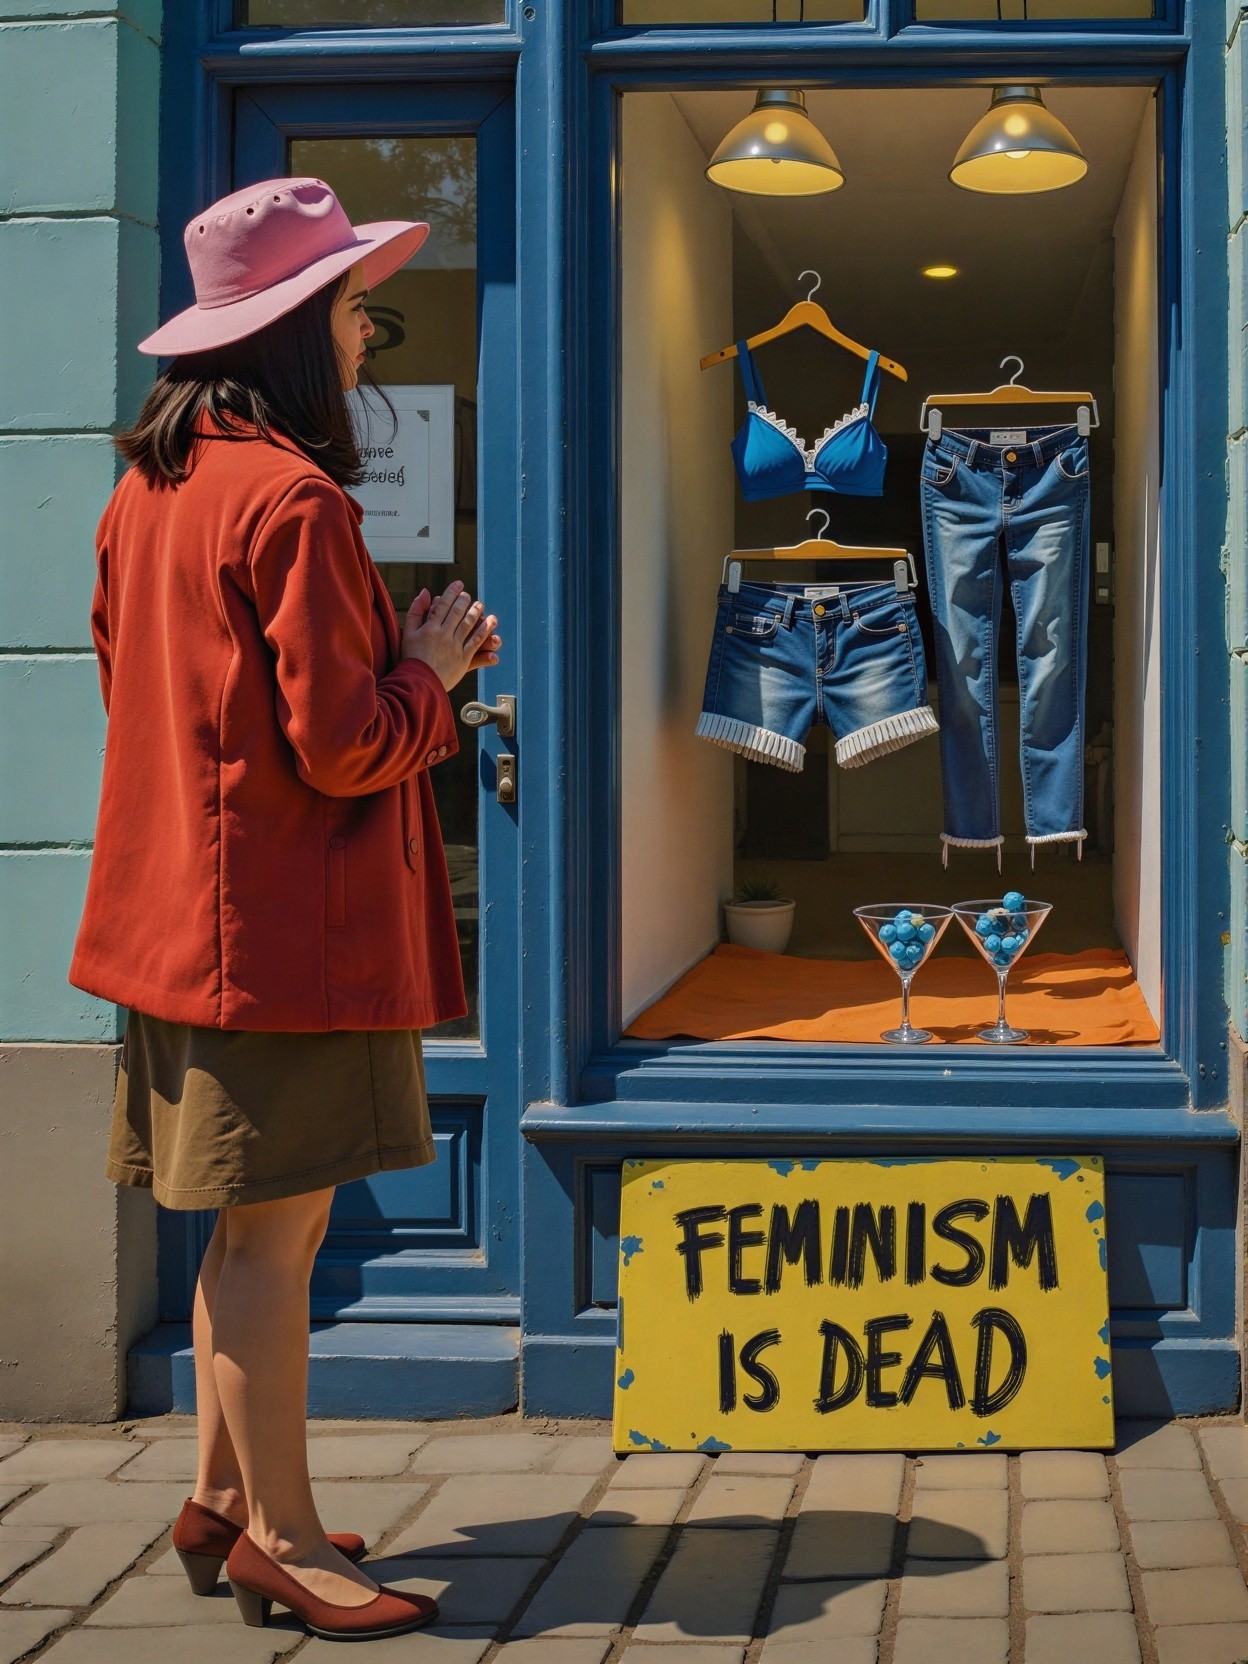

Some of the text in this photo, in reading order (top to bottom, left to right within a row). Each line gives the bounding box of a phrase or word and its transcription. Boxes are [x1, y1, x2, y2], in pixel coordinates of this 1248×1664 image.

[674, 1192, 1060, 1302] FEMINISM
[719, 1307, 1027, 1418] IS DEAD
